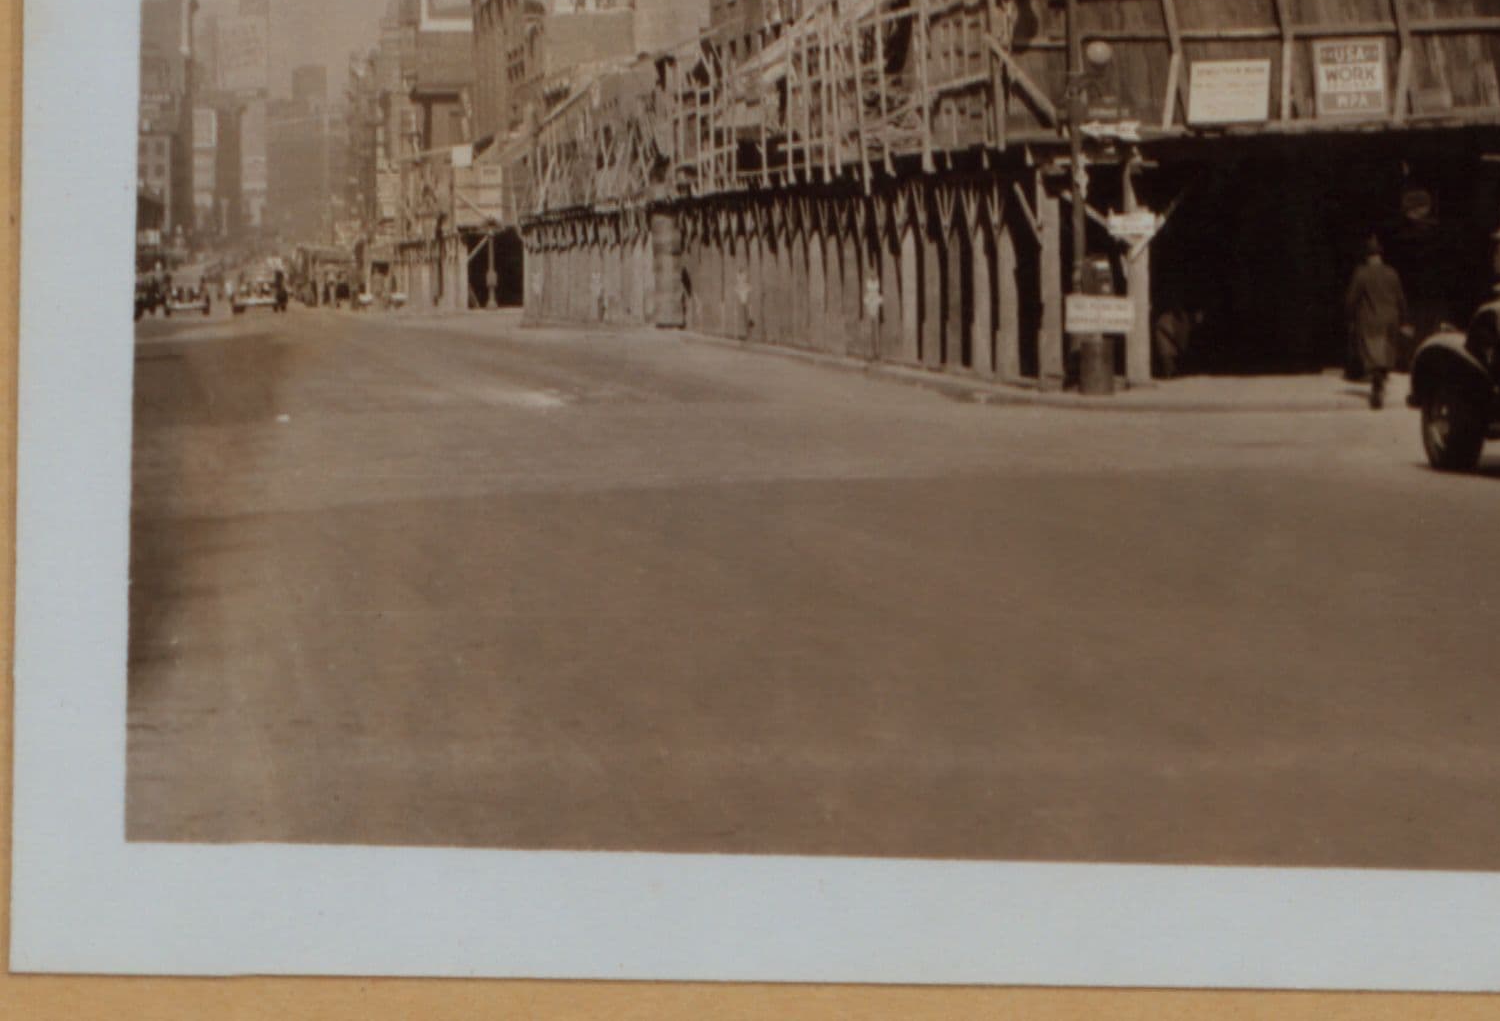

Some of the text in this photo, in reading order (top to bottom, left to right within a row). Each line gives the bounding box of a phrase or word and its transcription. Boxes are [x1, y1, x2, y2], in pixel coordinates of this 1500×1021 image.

[1333, 45, 1366, 63] USA
[1324, 65, 1376, 82] WORK
[1336, 92, 1370, 108] WPA
